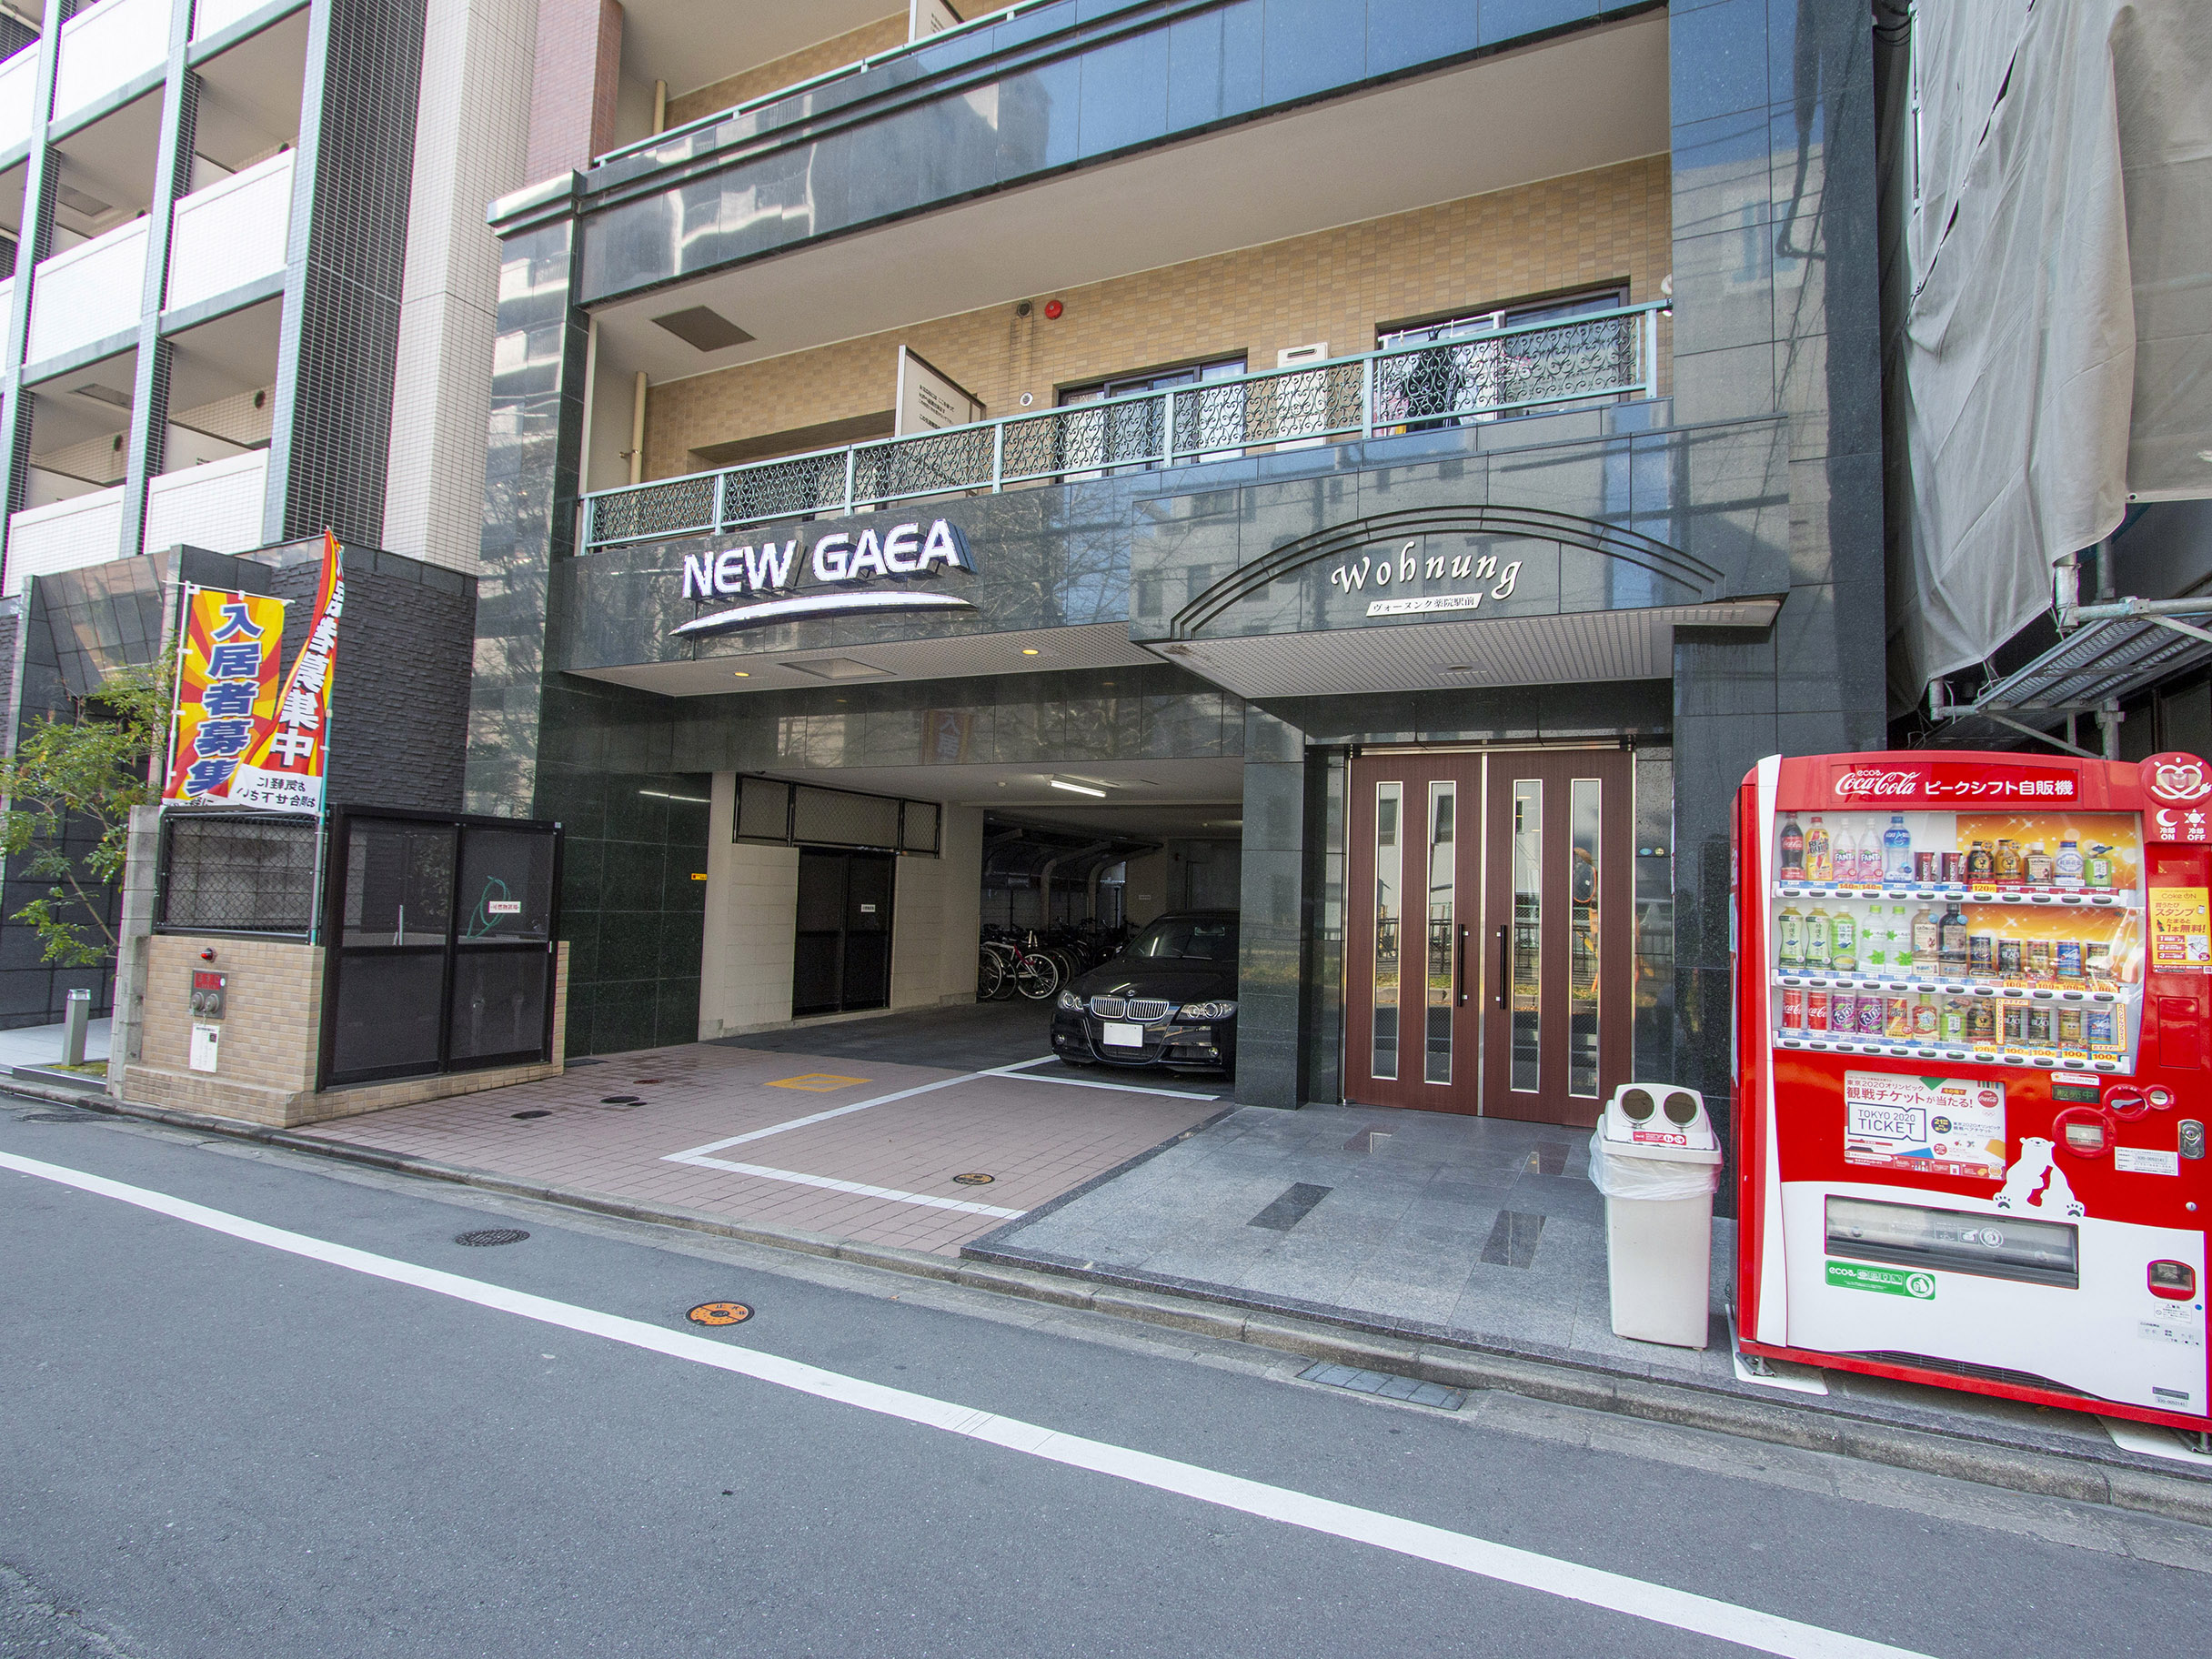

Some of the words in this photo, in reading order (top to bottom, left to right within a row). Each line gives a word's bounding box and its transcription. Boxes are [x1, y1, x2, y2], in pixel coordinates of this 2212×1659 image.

[682, 539, 798, 598] NEW
[812, 518, 960, 582] GAEA
[1331, 541, 1523, 599] Wohnung
[1835, 771, 1921, 796] Coca-Cola
[1925, 780, 2074, 796] ピークシフト自販機
[1847, 1080, 1924, 1091] 東京2020オリンピック
[2057, 1088, 2093, 1099] 販売中
[1847, 1087, 1972, 1109] 観戦チケットが当たる!
[1858, 1109, 1891, 1121] TOKYO
[1893, 1112, 1915, 1121] 2020
[1858, 1118, 1915, 1134] TICKET
